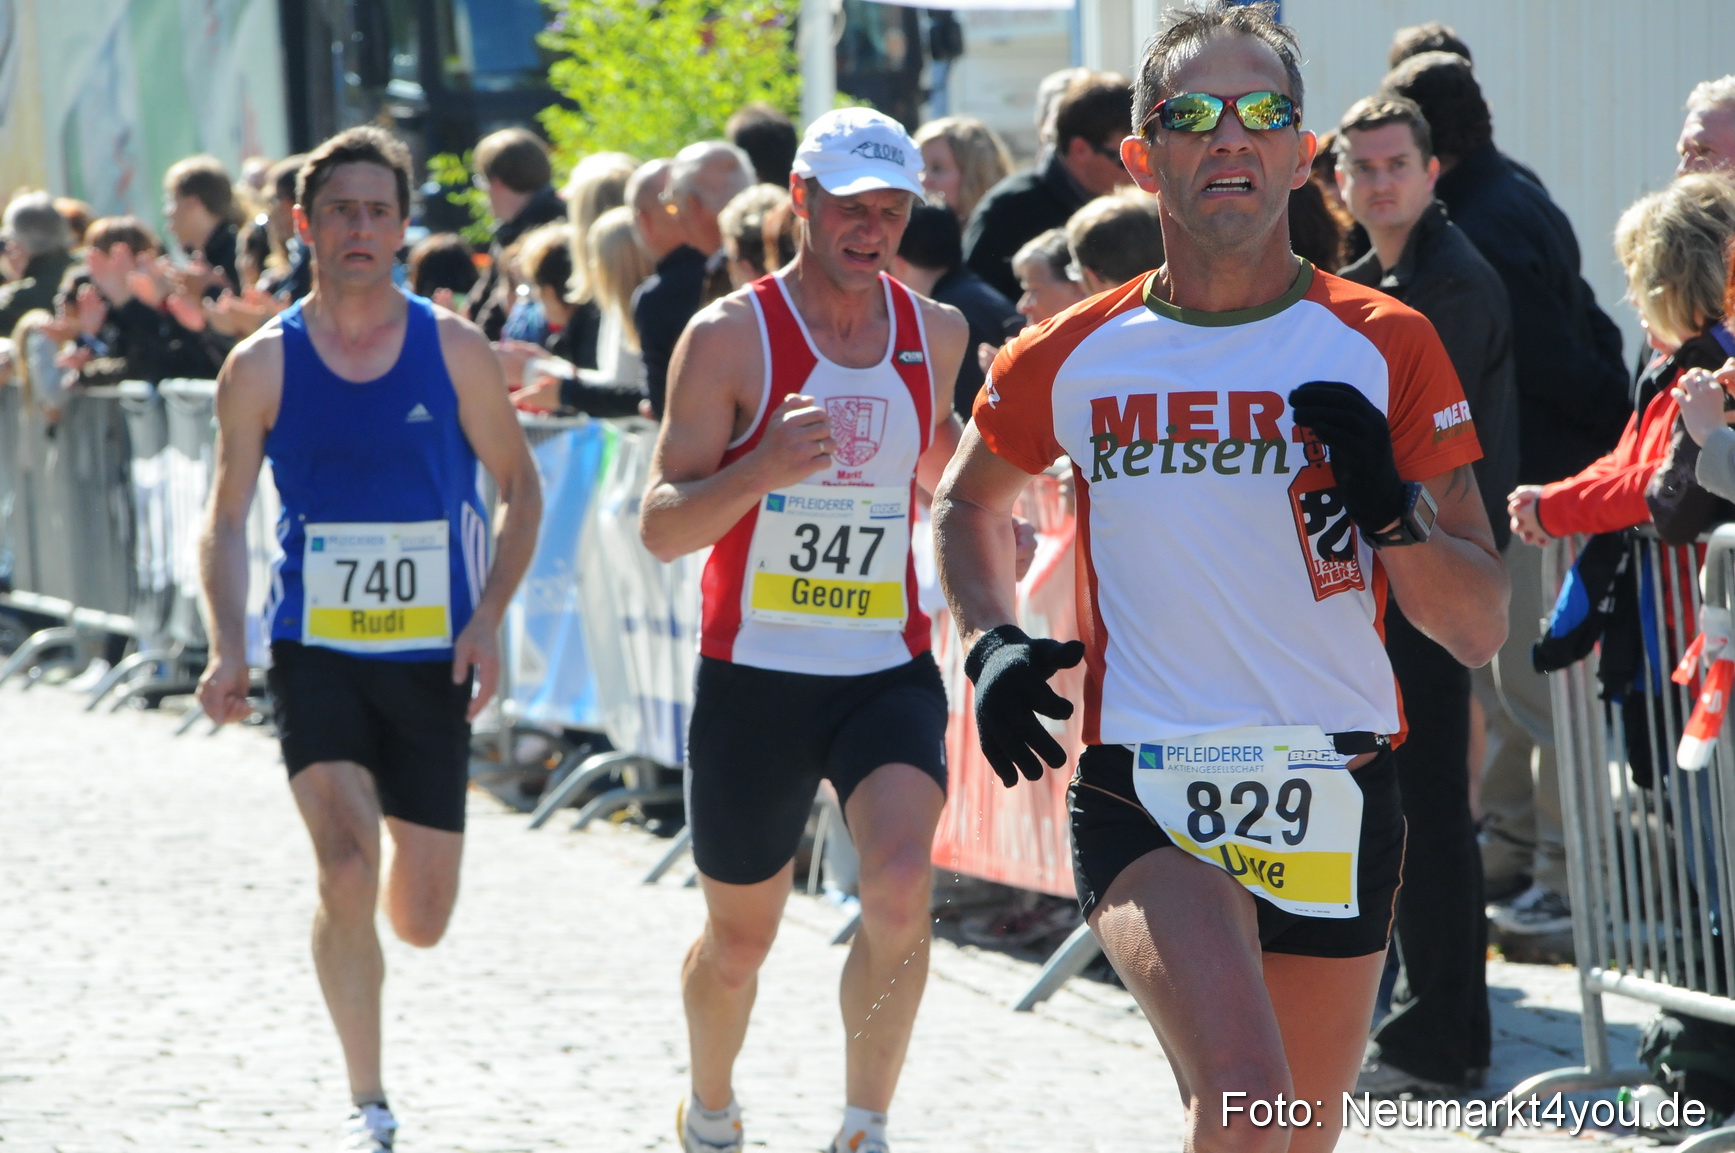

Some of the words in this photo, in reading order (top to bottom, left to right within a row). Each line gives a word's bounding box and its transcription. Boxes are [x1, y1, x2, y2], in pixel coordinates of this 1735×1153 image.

[1089, 391, 1310, 451] MER
[1090, 424, 1290, 483] Reisen
[788, 496, 854, 511] PFLEIDERER
[790, 523, 885, 576] 347
[335, 558, 416, 603] 740
[791, 578, 871, 616] Georg
[1317, 567, 1361, 586] MERZ
[352, 609, 405, 633] Rudi
[1167, 745, 1264, 762] PFLEIDERER
[1168, 764, 1265, 774] AKTIENGESELLSCHAFT
[1186, 778, 1312, 846] 829
[1219, 844, 1285, 889] Uwe
